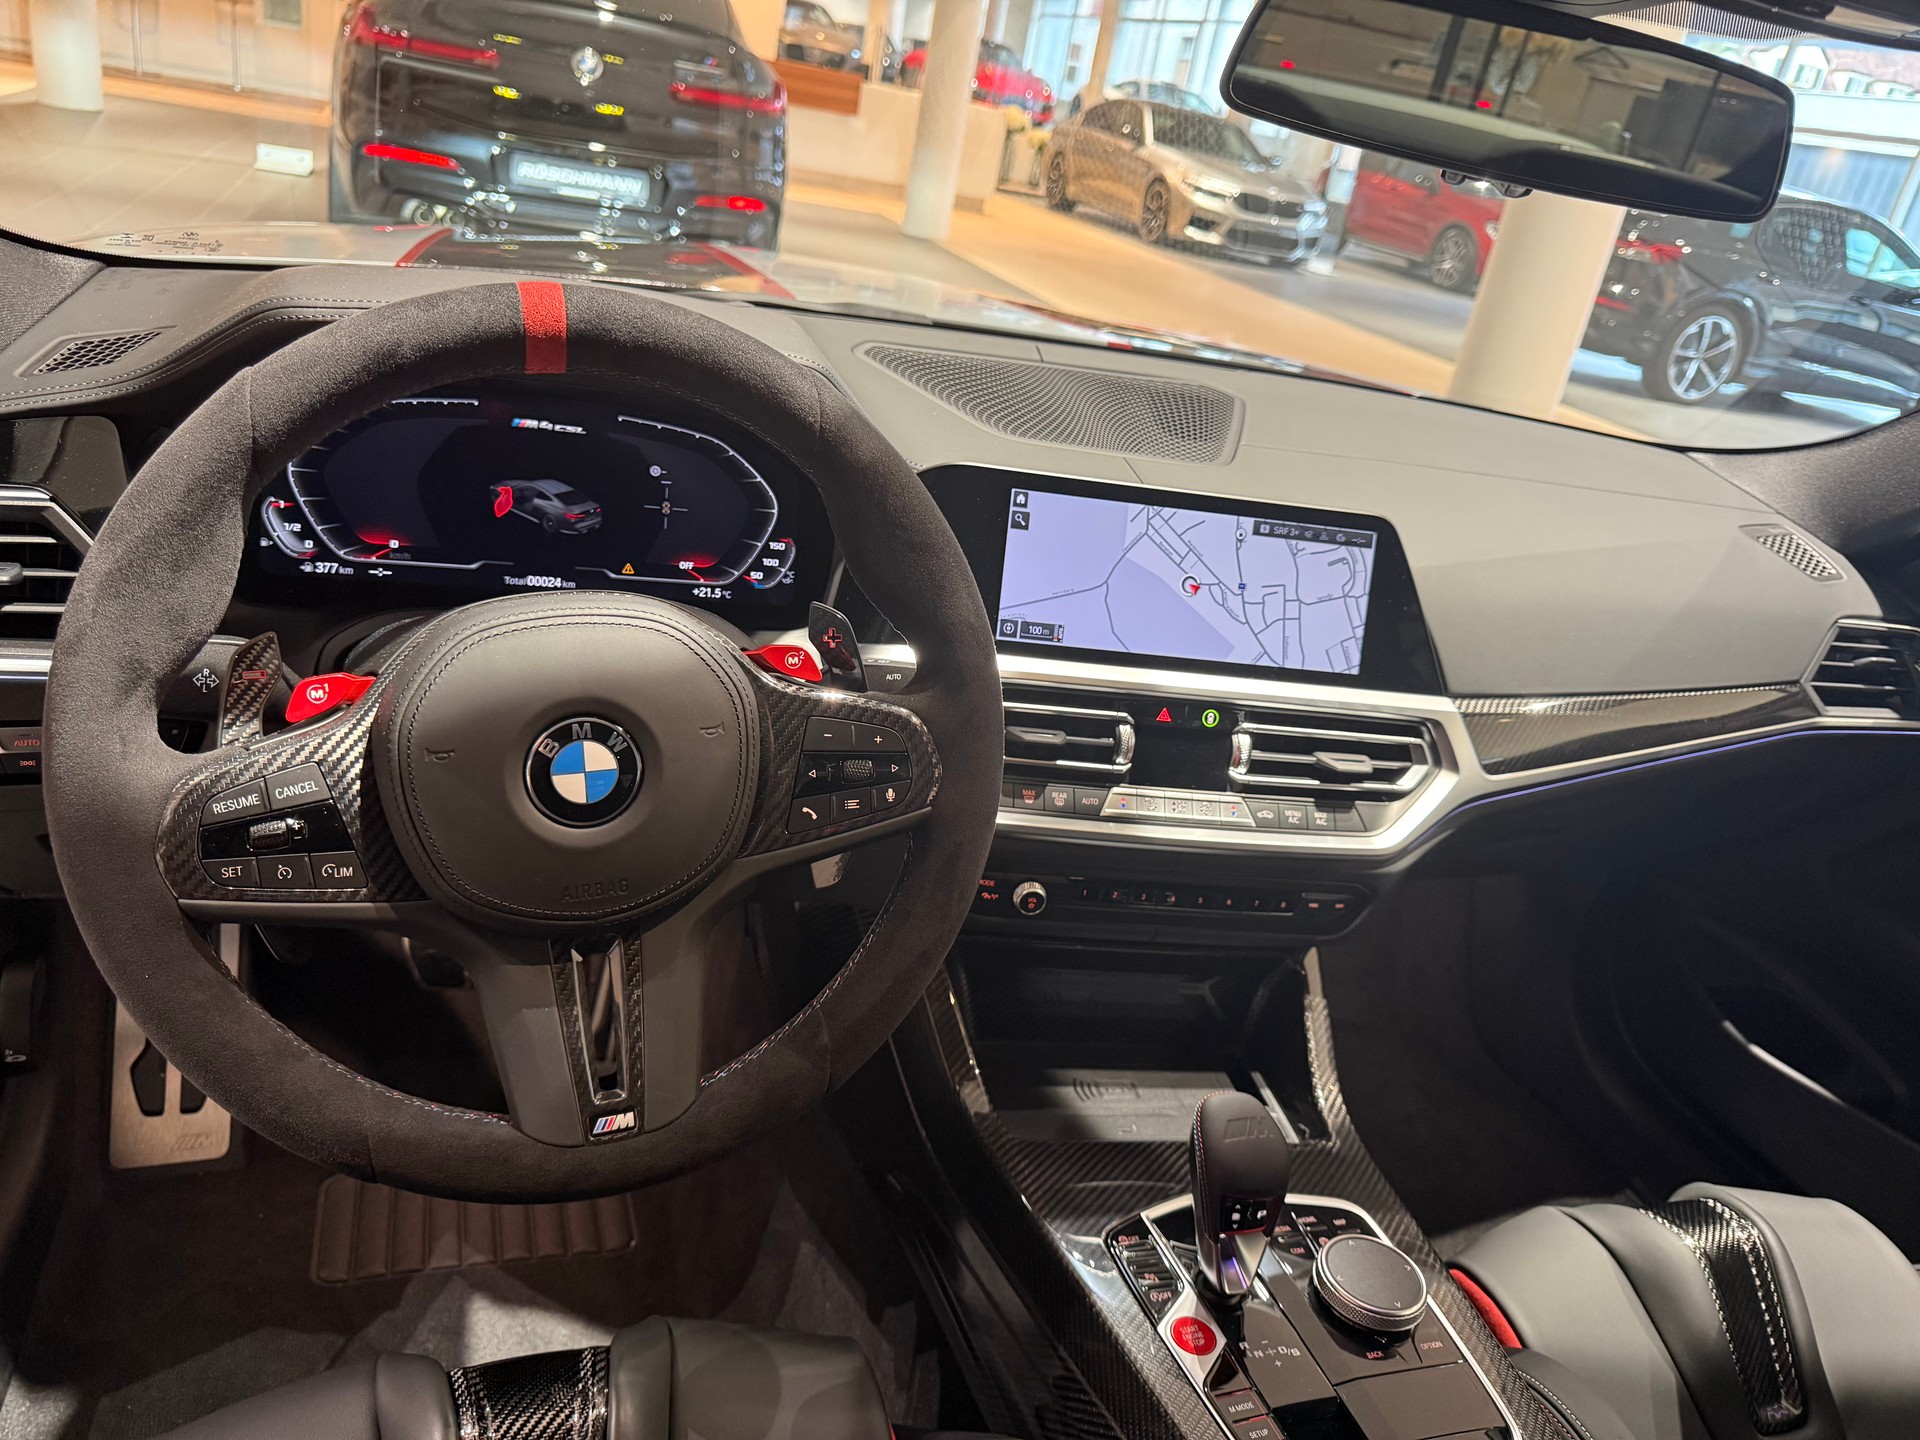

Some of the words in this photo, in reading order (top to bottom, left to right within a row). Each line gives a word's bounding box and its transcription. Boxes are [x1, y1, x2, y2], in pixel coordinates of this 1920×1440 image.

[554, 424, 587, 434] CSL
[283, 523, 302, 531] 1/2
[1273, 526, 1289, 535] SRF
[769, 542, 786, 550] 150
[679, 561, 695, 570] OFF
[762, 558, 779, 567] 100
[314, 562, 339, 574] 377
[339, 567, 354, 575] km
[750, 571, 764, 580] 50
[504, 576, 527, 586] Total
[526, 575, 562, 588] 00024
[562, 581, 576, 589] km
[692, 586, 722, 599] +21.5
[722, 590, 732, 599] °C
[1028, 625, 1043, 635] 100
[203, 669, 210, 677] R
[886, 673, 902, 681] AUTO
[202, 684, 208, 693] L
[14, 739, 41, 747] AUTO
[538, 723, 628, 759] BMW
[275, 780, 319, 799] CANCEL
[1051, 791, 1068, 799] REAR
[212, 793, 261, 815] RESUME
[1081, 797, 1099, 805] AUTO
[221, 866, 242, 878] SET
[334, 867, 353, 878] LIM
[561, 878, 629, 902] AIRBAG
[1180, 1325, 1199, 1333] START
[1188, 1338, 1205, 1348] STOP
[1420, 1340, 1443, 1350] OPTION
[1253, 1348, 1264, 1358] N
[1277, 1345, 1301, 1356] D/S
[1366, 1350, 1384, 1359] BACK
[1236, 1401, 1255, 1411] MODE
[1249, 1428, 1269, 1439] SETUP
